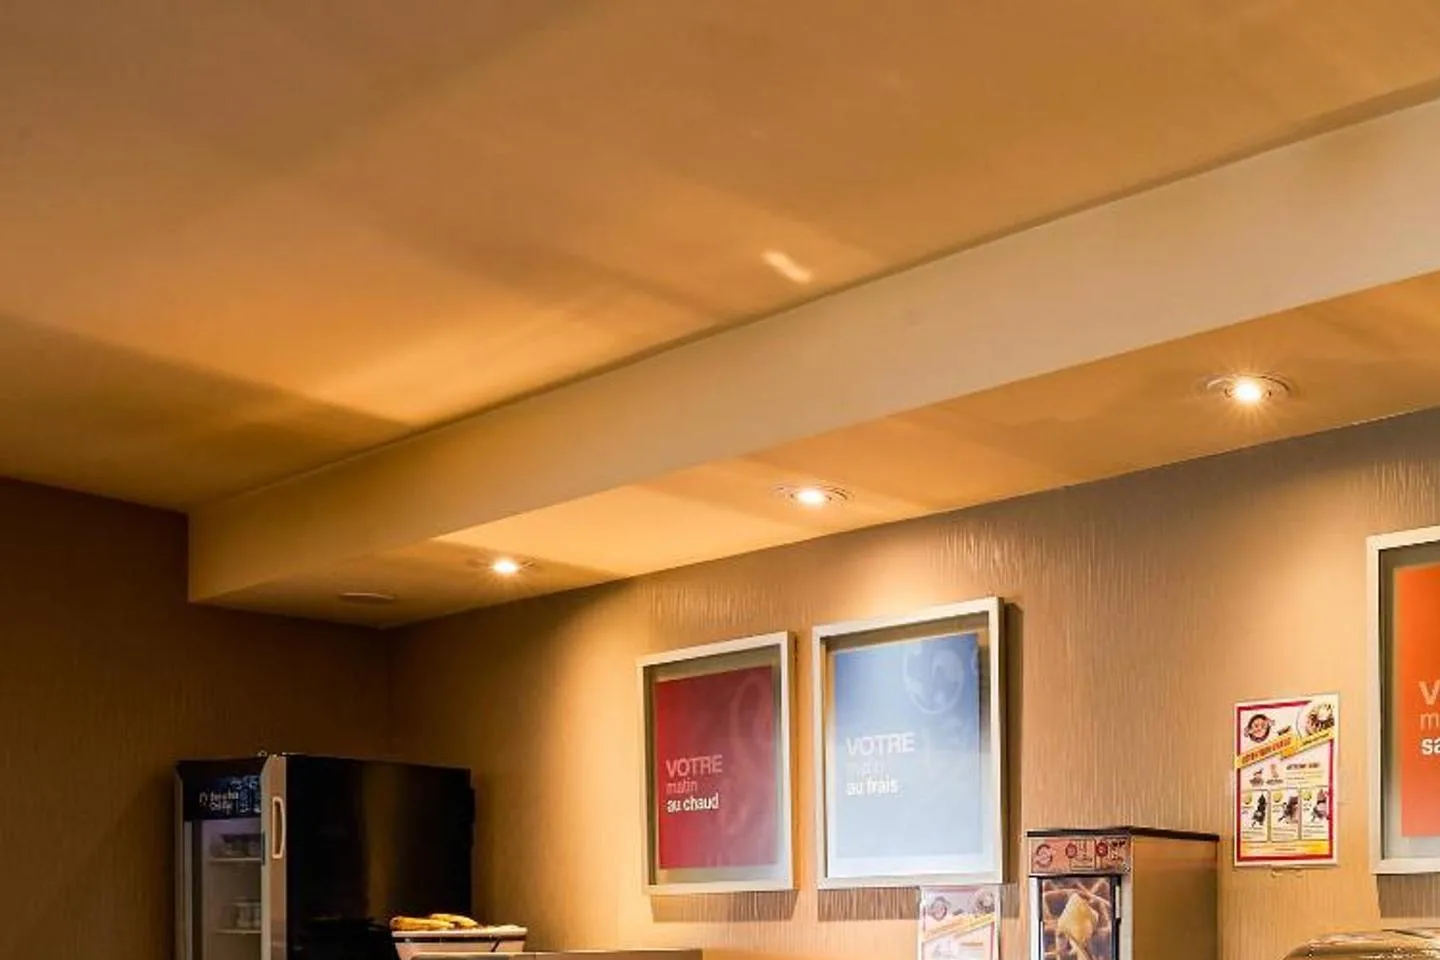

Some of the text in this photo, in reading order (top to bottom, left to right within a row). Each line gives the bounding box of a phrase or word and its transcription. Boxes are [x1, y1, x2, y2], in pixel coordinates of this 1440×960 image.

[845, 731, 916, 756] VOTRE
[665, 754, 724, 778] VOTRE
[845, 773, 899, 796] au frais
[666, 791, 720, 813] au chaud
